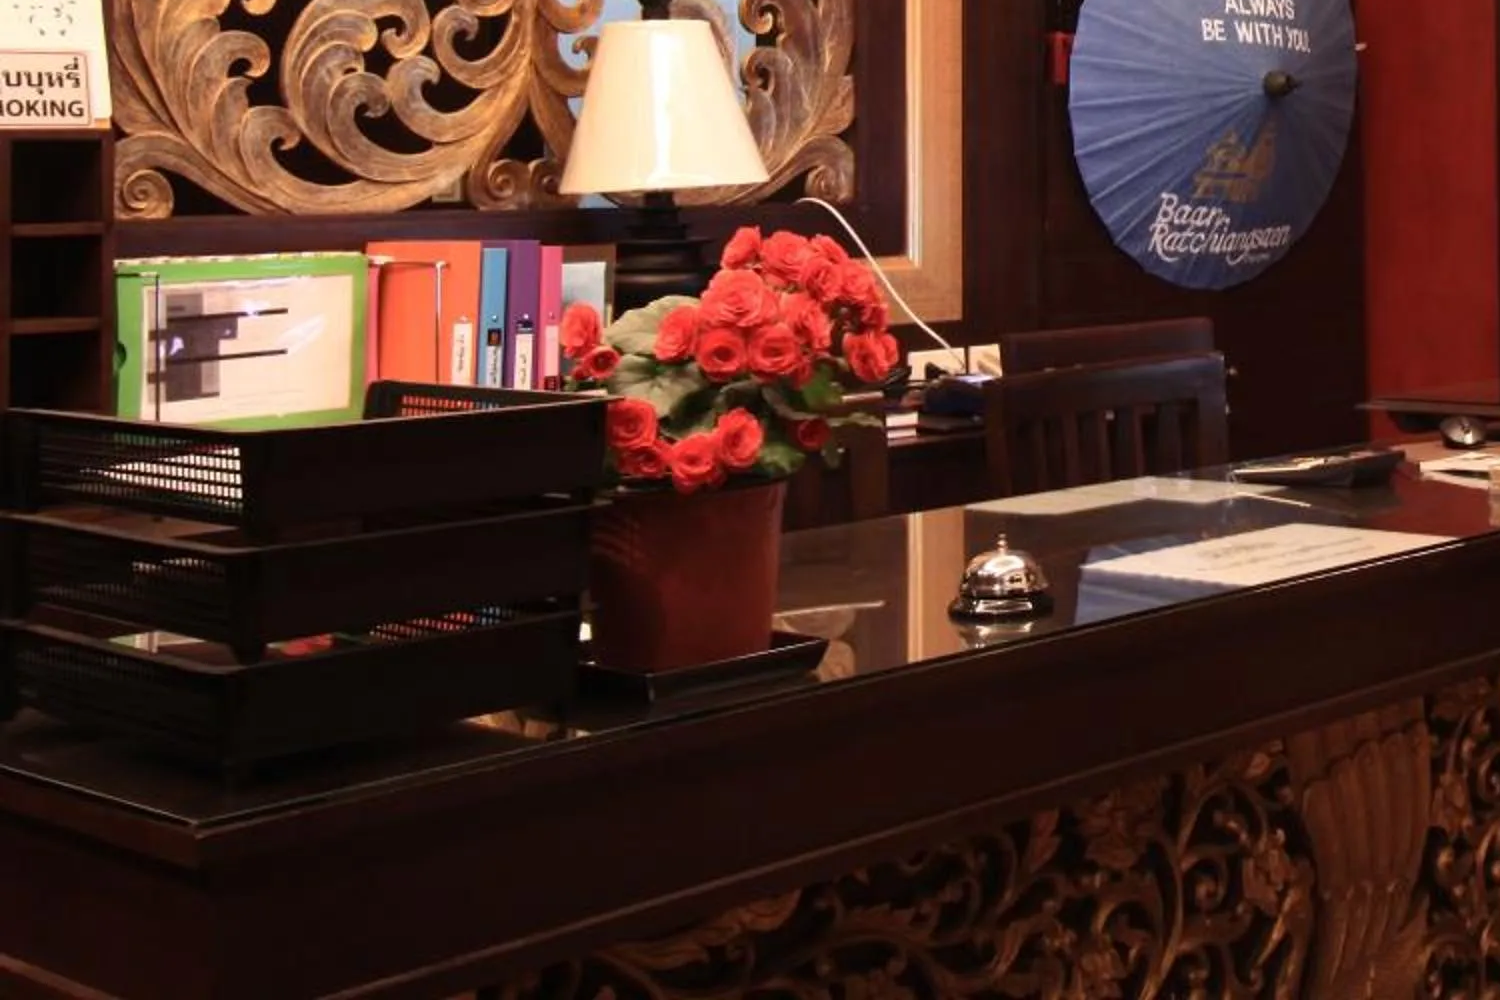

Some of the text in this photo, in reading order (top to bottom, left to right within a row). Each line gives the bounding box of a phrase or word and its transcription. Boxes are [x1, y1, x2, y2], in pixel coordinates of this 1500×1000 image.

[1201, 17, 1227, 41] BE
[1234, 20, 1284, 48] WITH
[0, 99, 84, 117] OKING
